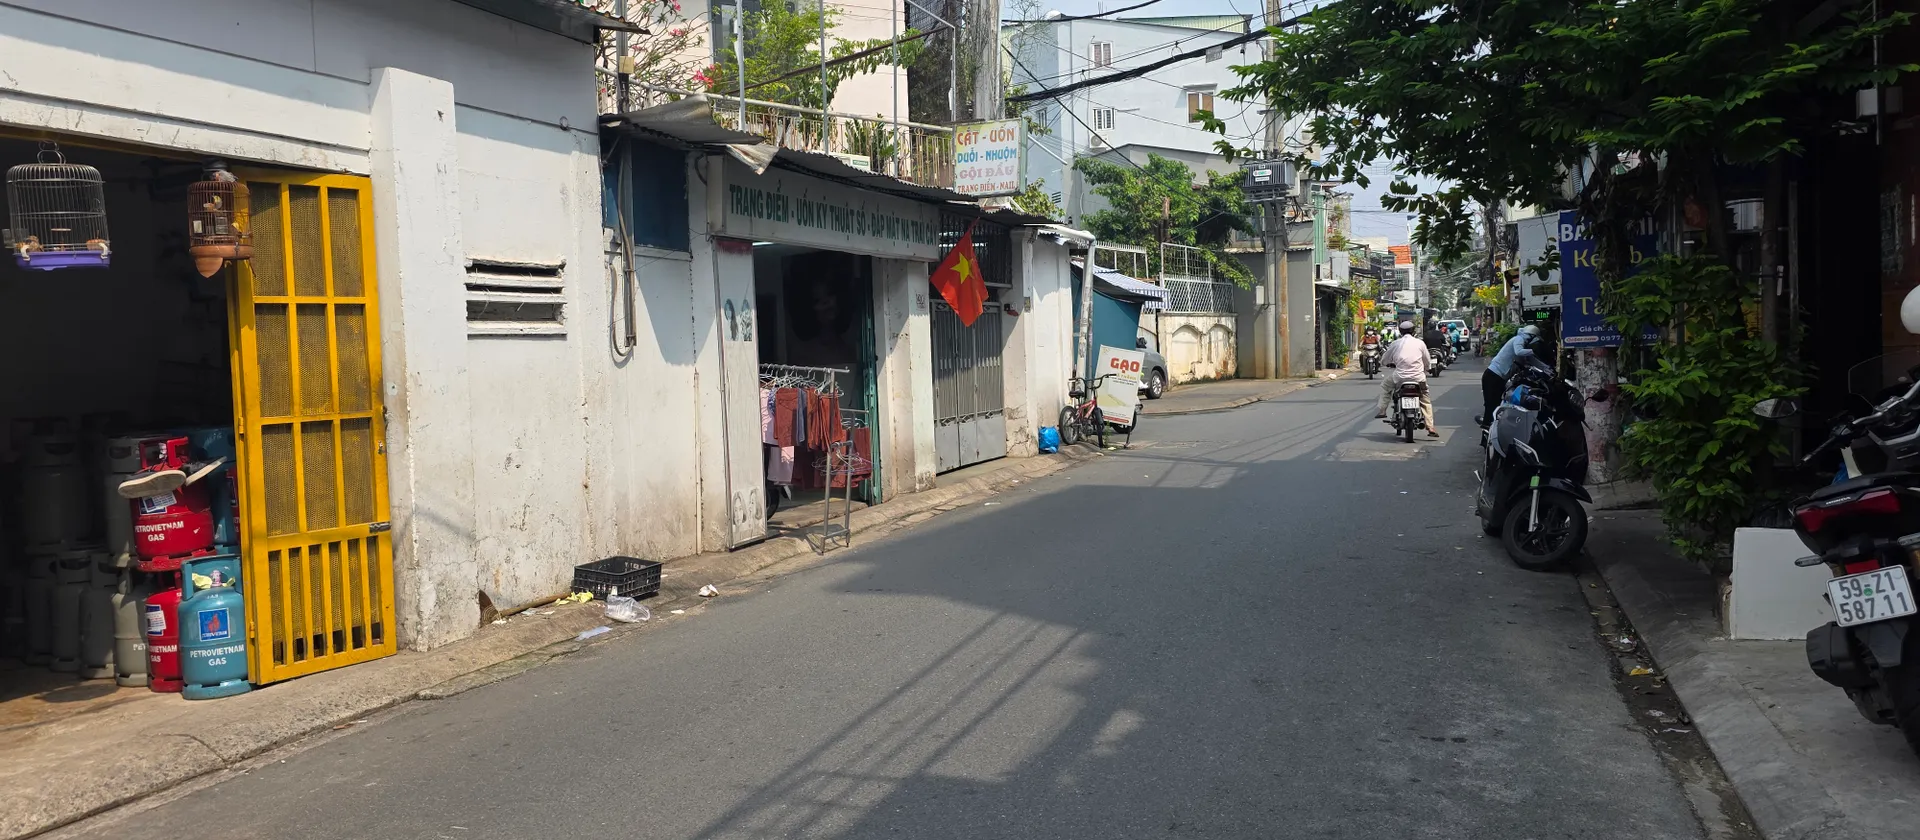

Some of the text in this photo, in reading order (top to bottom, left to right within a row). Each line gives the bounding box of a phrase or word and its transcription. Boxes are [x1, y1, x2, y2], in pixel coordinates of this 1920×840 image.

[989, 123, 1015, 143] UỐN
[985, 146, 1017, 162] NHUỘM
[959, 162, 1014, 181] GỘI ĐẦU
[957, 183, 979, 193] TRANG
[999, 180, 1016, 191] NAIL
[729, 183, 764, 219] TRANG
[765, 179, 789, 224] ĐIỂM
[796, 187, 814, 228] UỐN
[829, 201, 854, 241] THUẬT
[856, 200, 866, 237] SỐ
[901, 218, 911, 248] NẠ
[1110, 357, 1140, 374] GẠO
[134, 520, 185, 533] PETROVIETNAM
[147, 533, 165, 542] GAS
[1838, 571, 1896, 600] 59-Z1
[1839, 591, 1909, 623] 587.11
[190, 644, 245, 658] PETROVIETNAM
[208, 657, 227, 666] GAS
